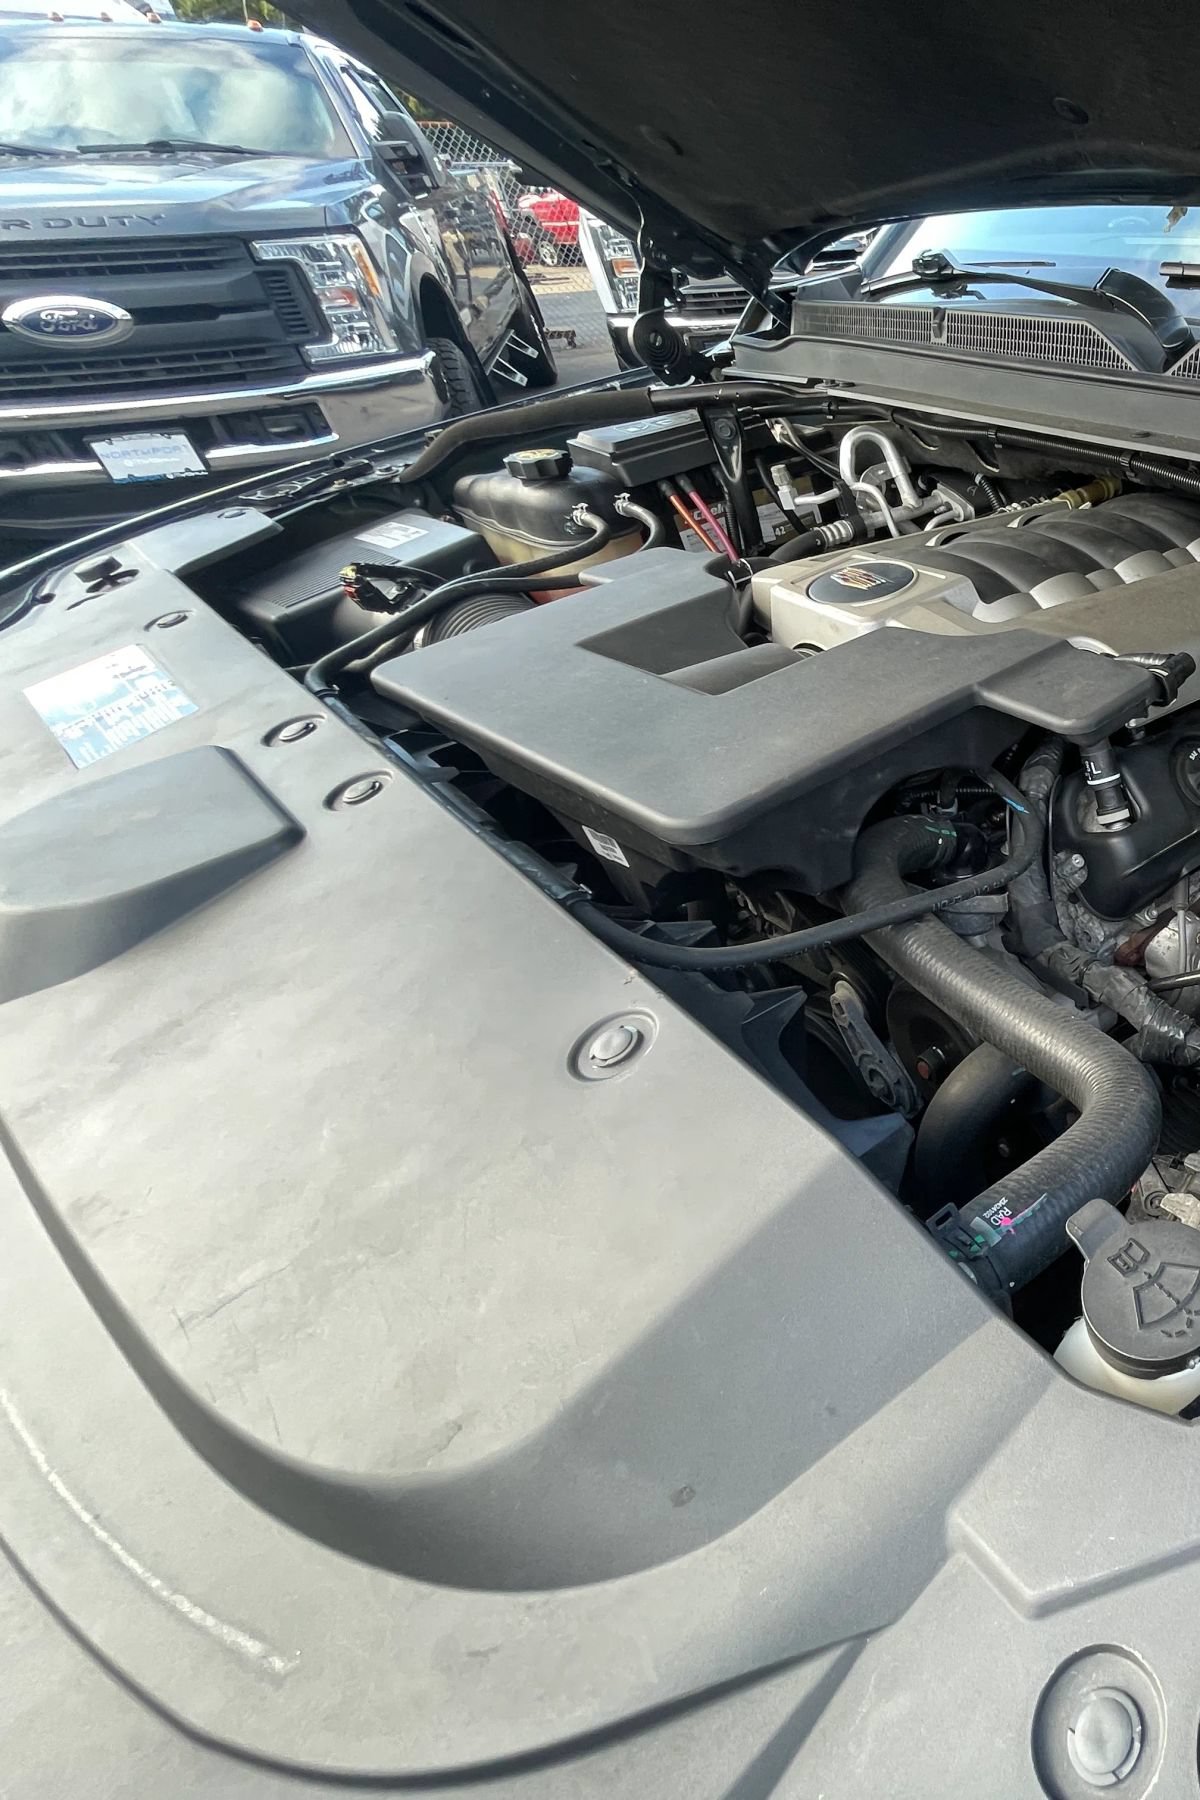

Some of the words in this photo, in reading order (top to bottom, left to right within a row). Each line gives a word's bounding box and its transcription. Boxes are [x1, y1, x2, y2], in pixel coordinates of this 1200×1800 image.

[42, 213, 166, 229] DUTY
[40, 310, 98, 333] Ford
[990, 1206, 1013, 1226] RAD
